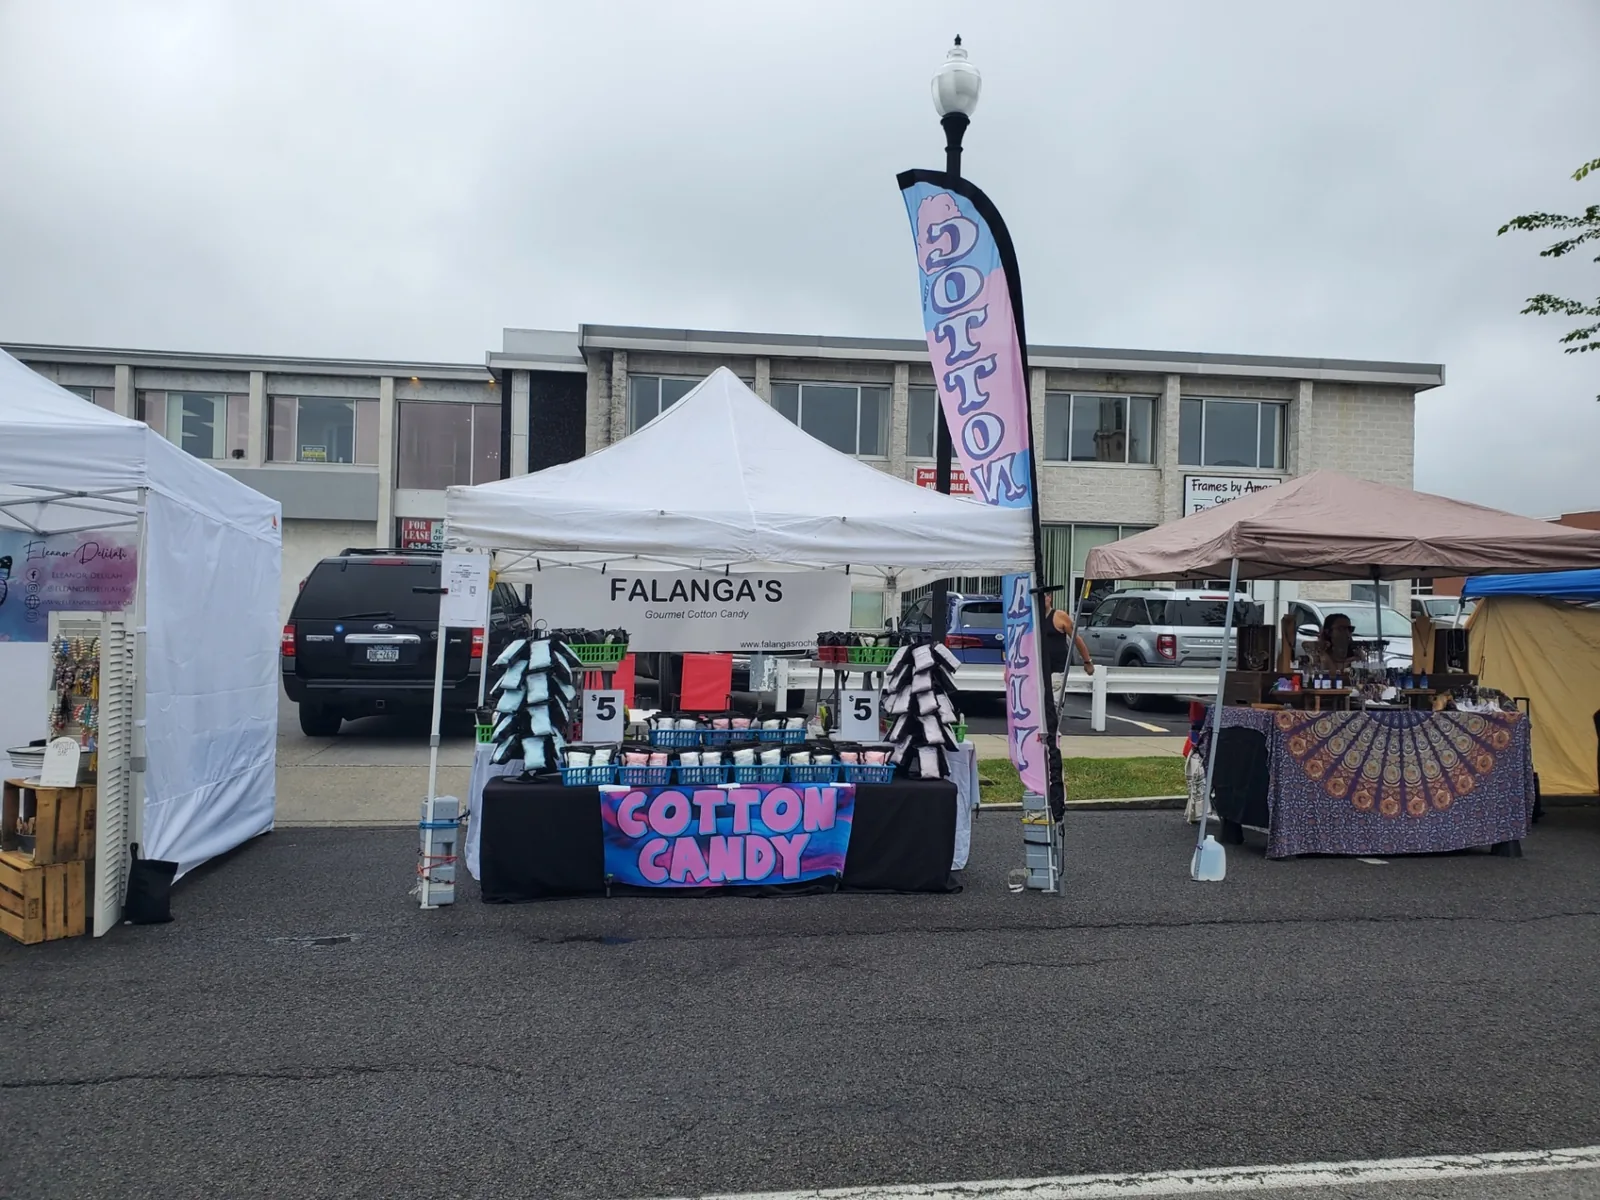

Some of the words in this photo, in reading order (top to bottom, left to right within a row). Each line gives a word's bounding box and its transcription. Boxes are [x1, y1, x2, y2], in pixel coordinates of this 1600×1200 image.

[919, 471, 934, 479] 2nd
[1192, 478, 1228, 492] Frames
[1230, 480, 1242, 495] by
[409, 520, 427, 530] FOR
[404, 530, 431, 540] LEASE
[23, 540, 71, 562] Eleanor
[73, 541, 128, 565] Delilah
[610, 578, 783, 603] FALANGA'S
[644, 609, 685, 619] Gourmet
[687, 609, 718, 619] Cotton
[720, 608, 749, 620] Candy
[740, 638, 818, 650] www.falangasroche
[617, 787, 838, 838] COTTON
[638, 833, 811, 884] CANDY
